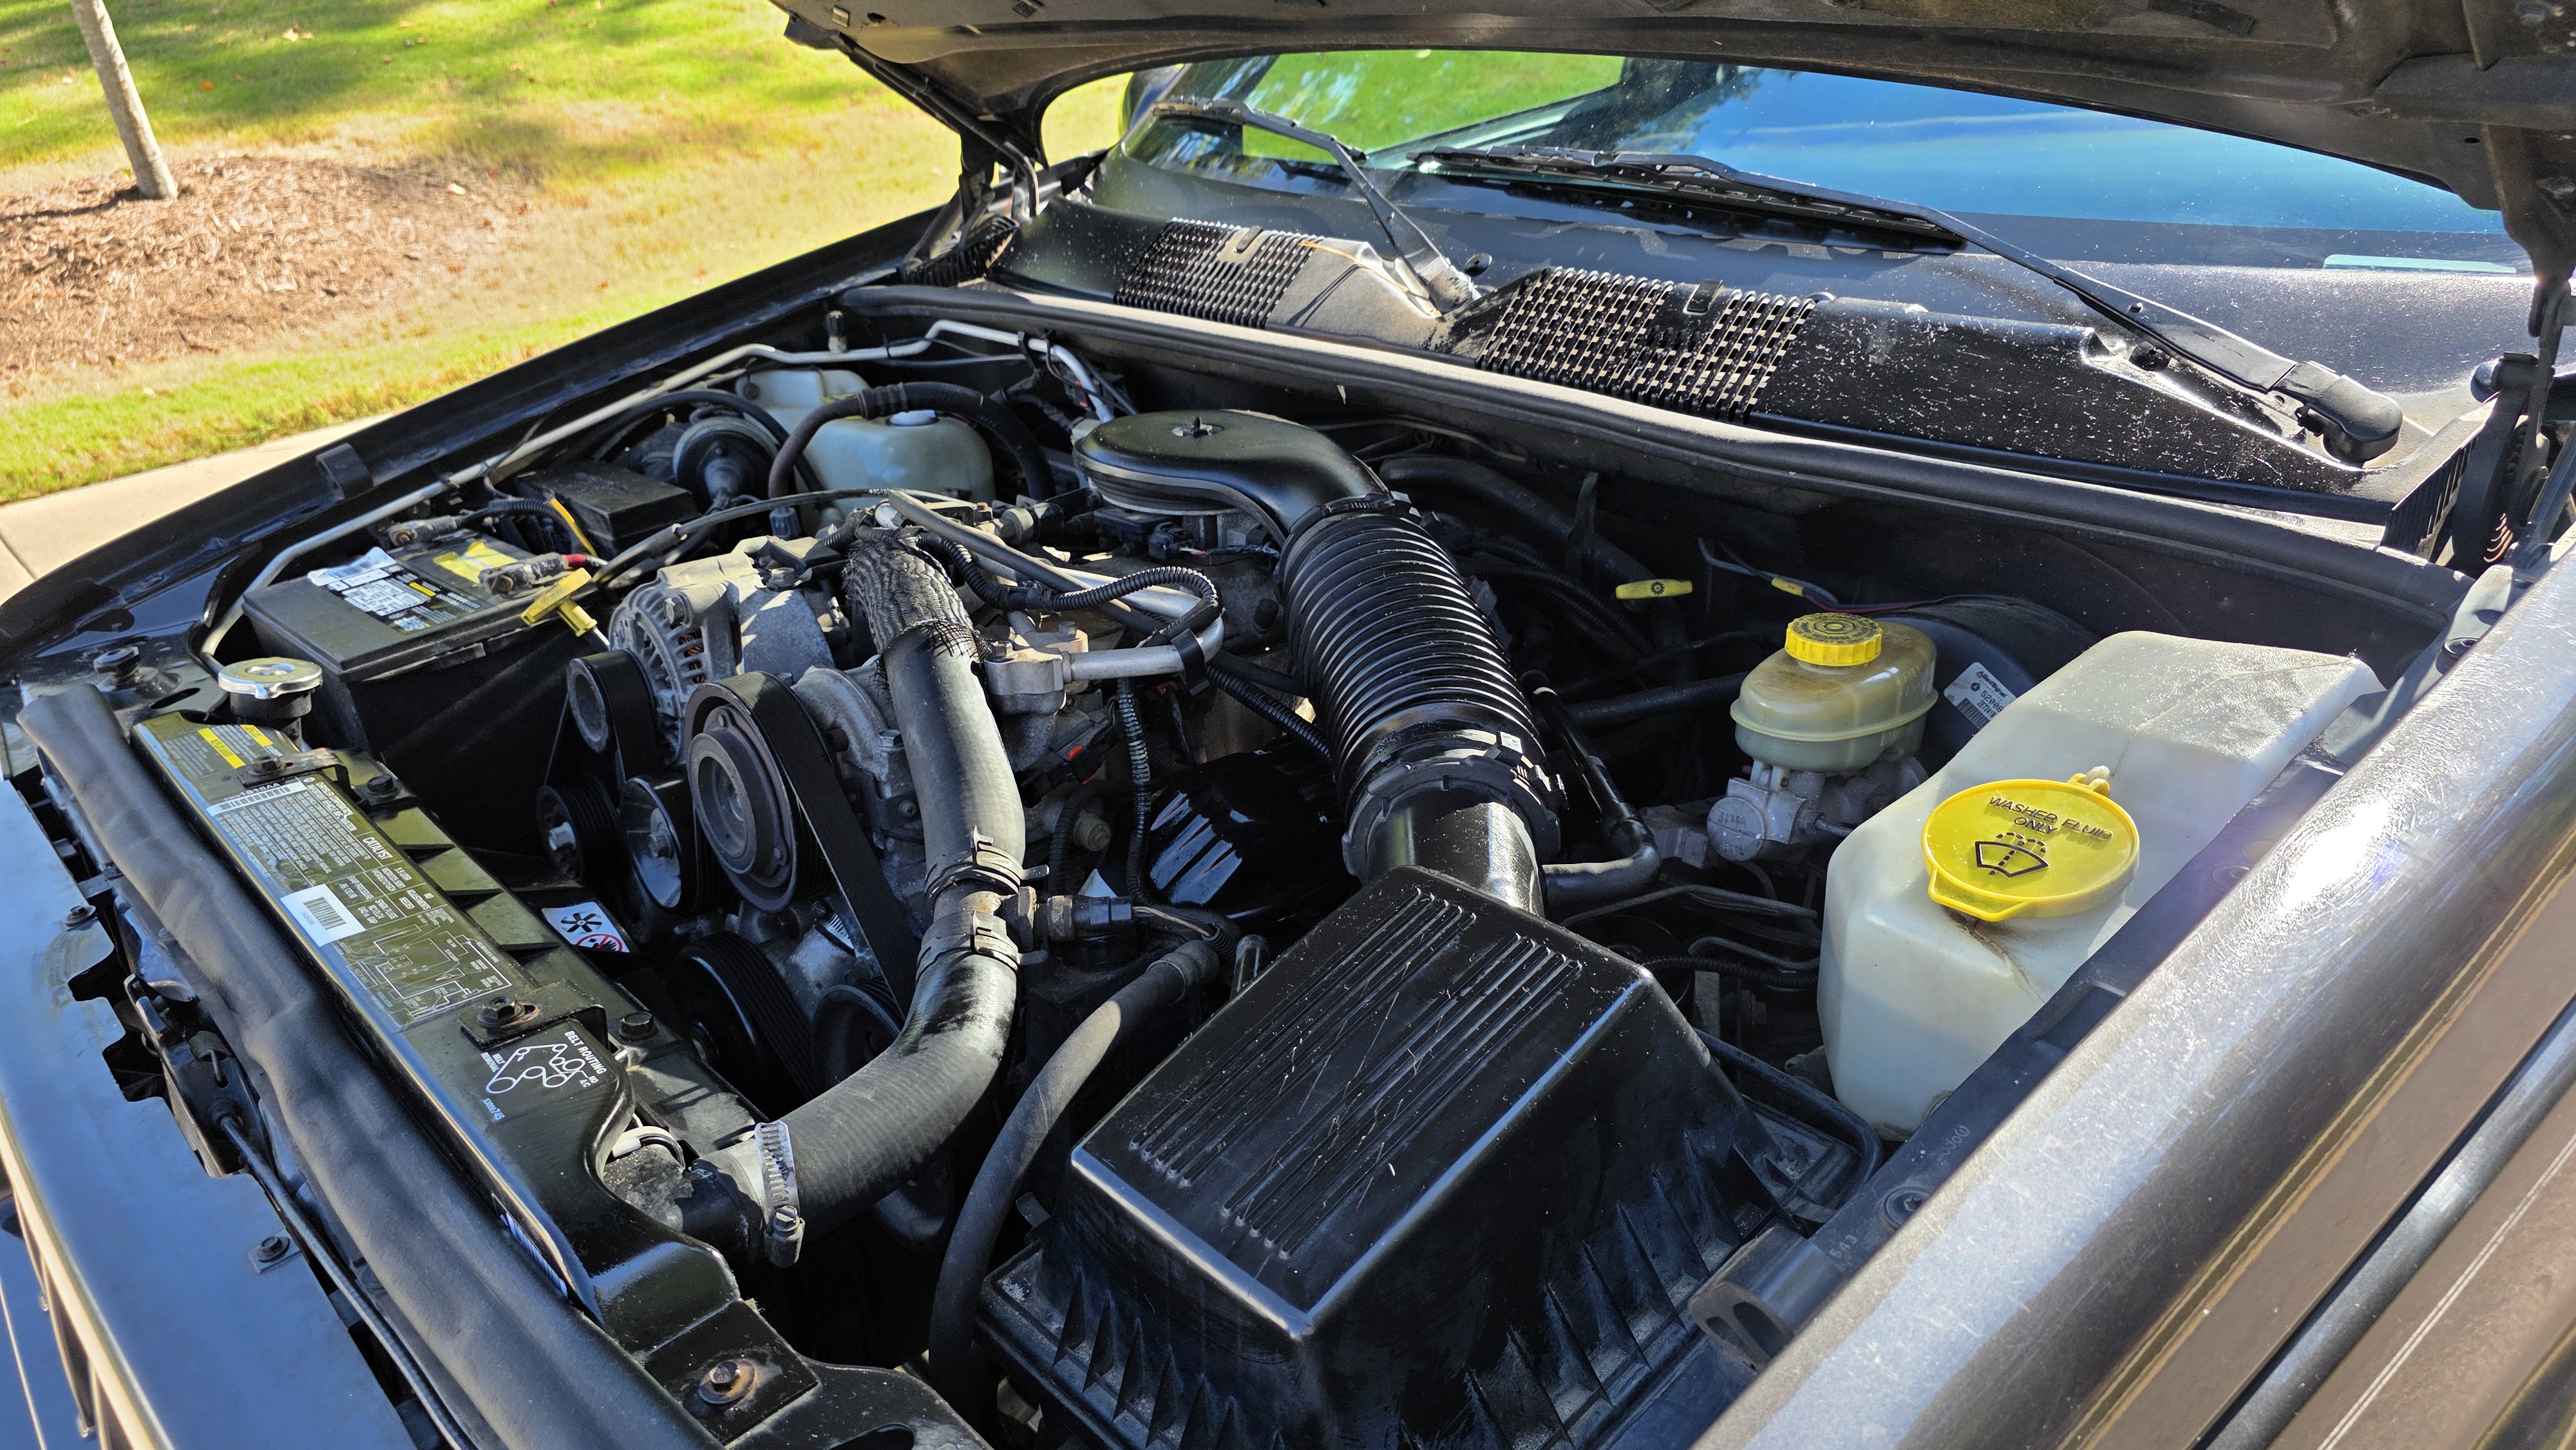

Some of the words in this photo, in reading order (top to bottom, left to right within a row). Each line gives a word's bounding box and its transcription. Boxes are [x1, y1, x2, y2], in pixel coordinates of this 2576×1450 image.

[1989, 796, 2059, 824] WASHER
[2061, 818, 2113, 840] FLUID
[2014, 817, 2059, 834] ONLY
[362, 836, 393, 860] CATALYST
[480, 1052, 500, 1073] REMOVAL
[493, 1053, 506, 1064] BELT
[565, 1031, 584, 1050] BELT
[578, 1046, 607, 1075] ROUTING
[588, 1075, 599, 1084] NO
